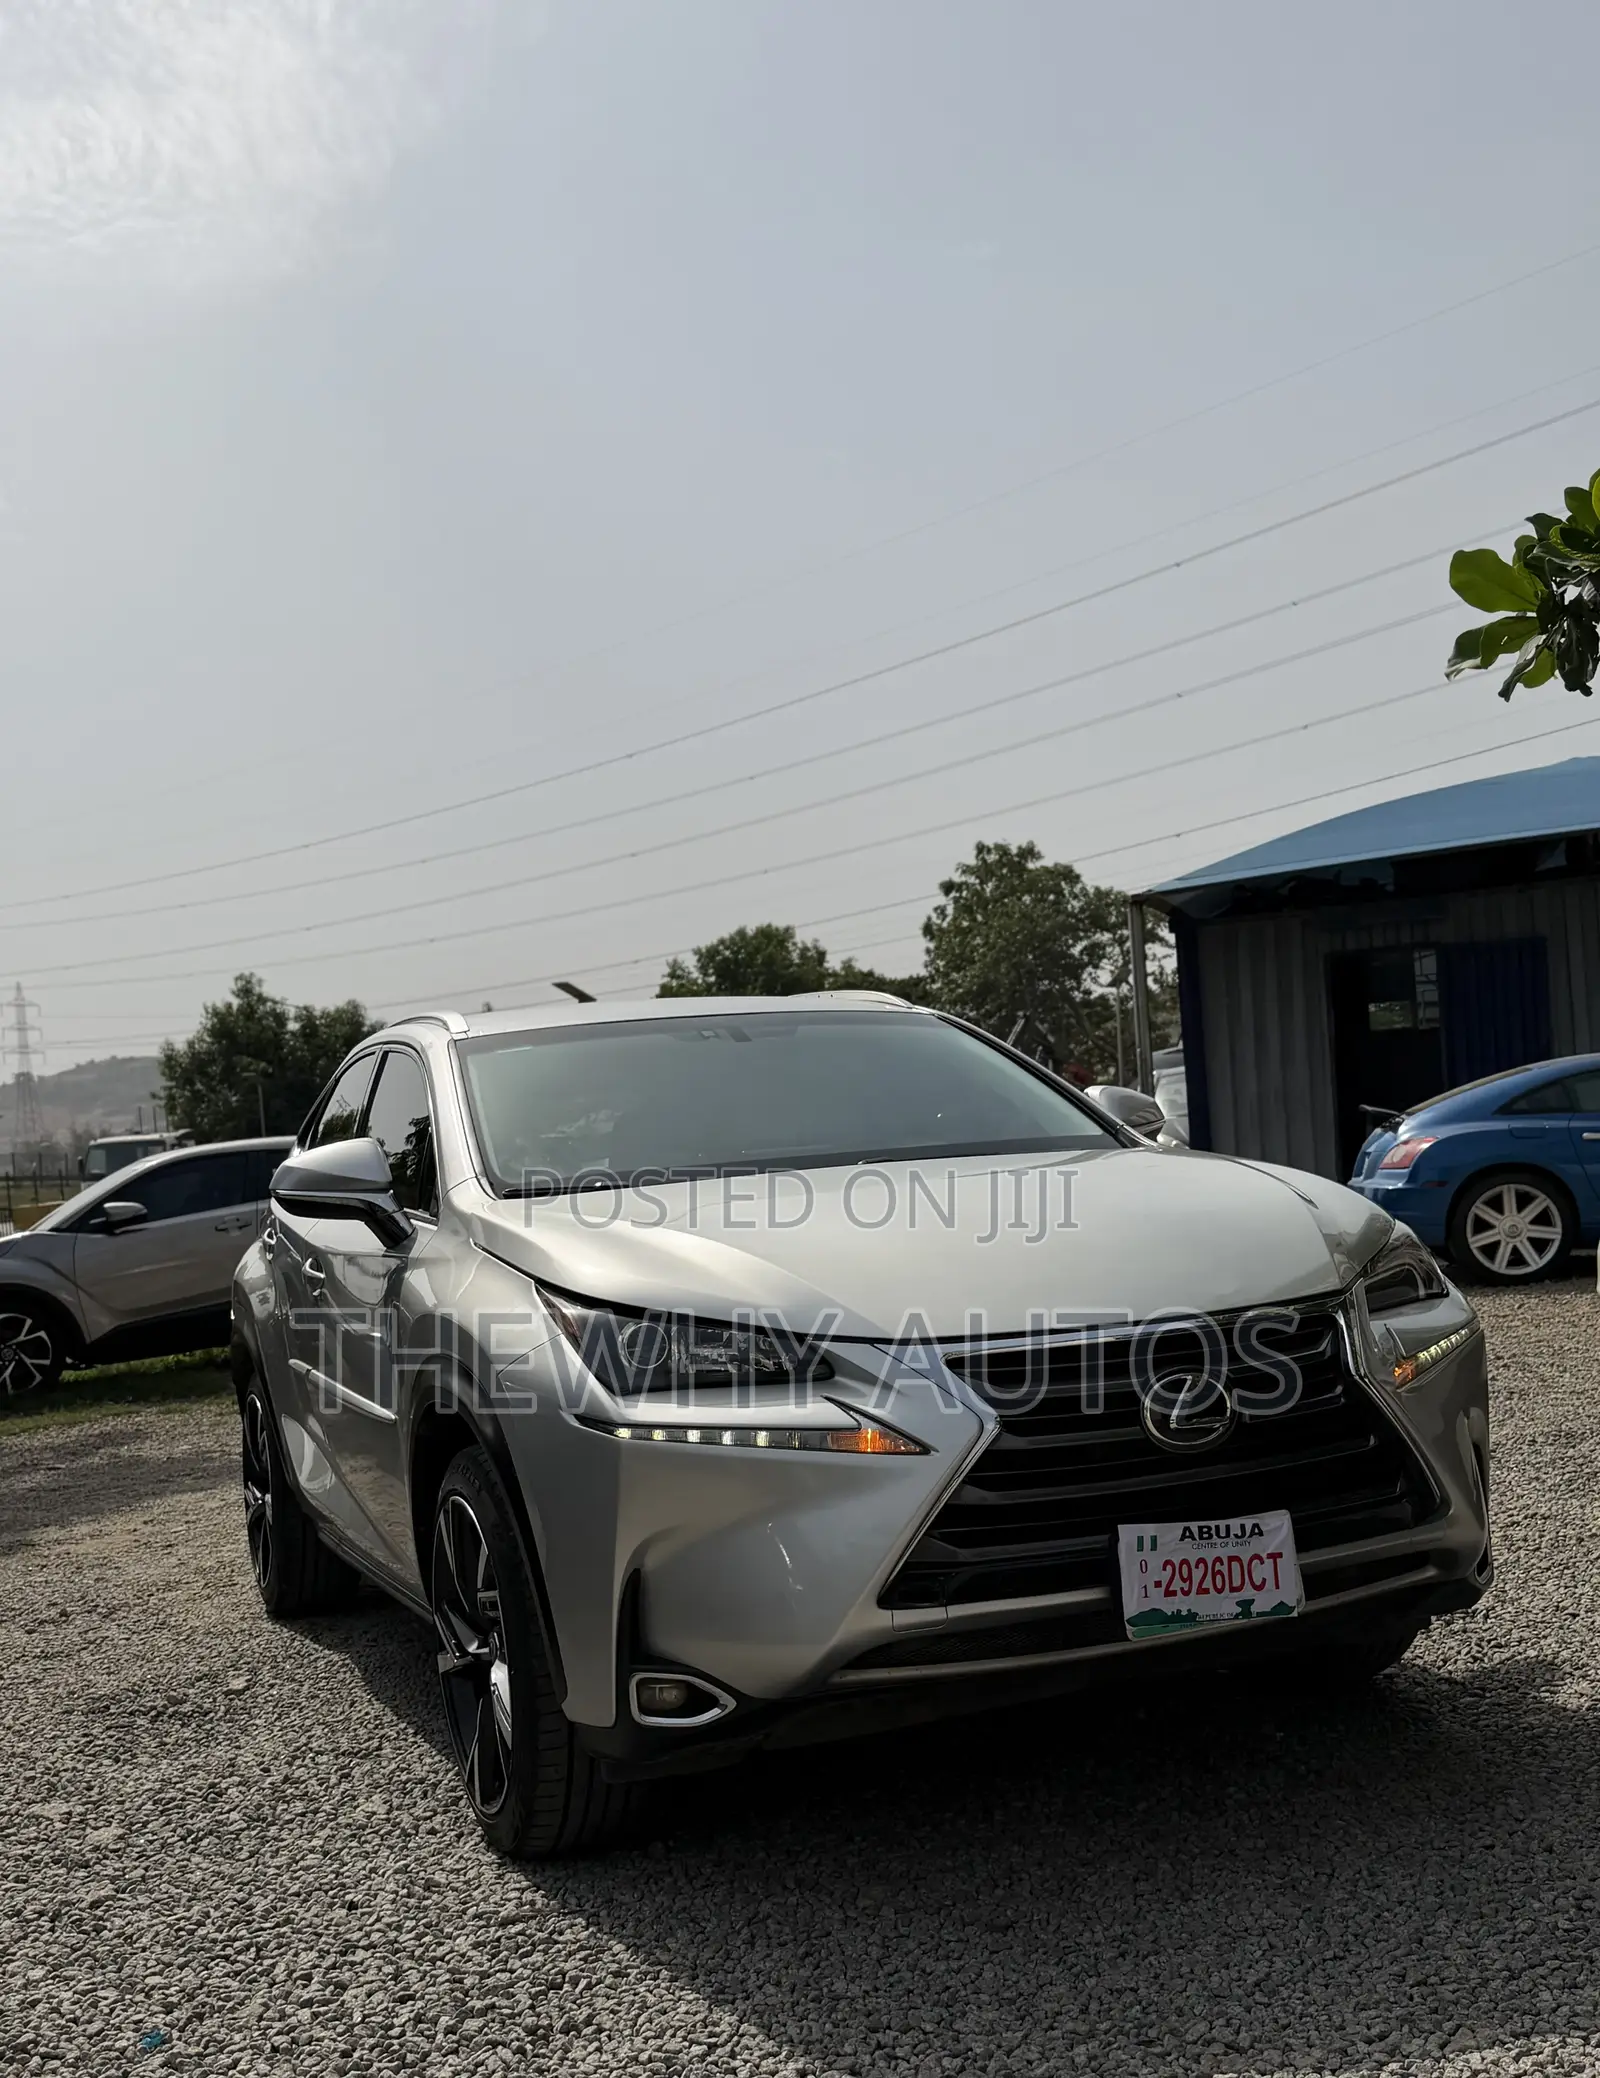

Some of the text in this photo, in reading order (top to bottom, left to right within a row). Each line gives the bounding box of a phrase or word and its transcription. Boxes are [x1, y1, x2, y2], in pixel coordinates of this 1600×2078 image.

[1178, 1522, 1264, 1542] ABUJA
[1191, 1541, 1217, 1550] CENTRE
[1231, 1540, 1251, 1548] UNITY
